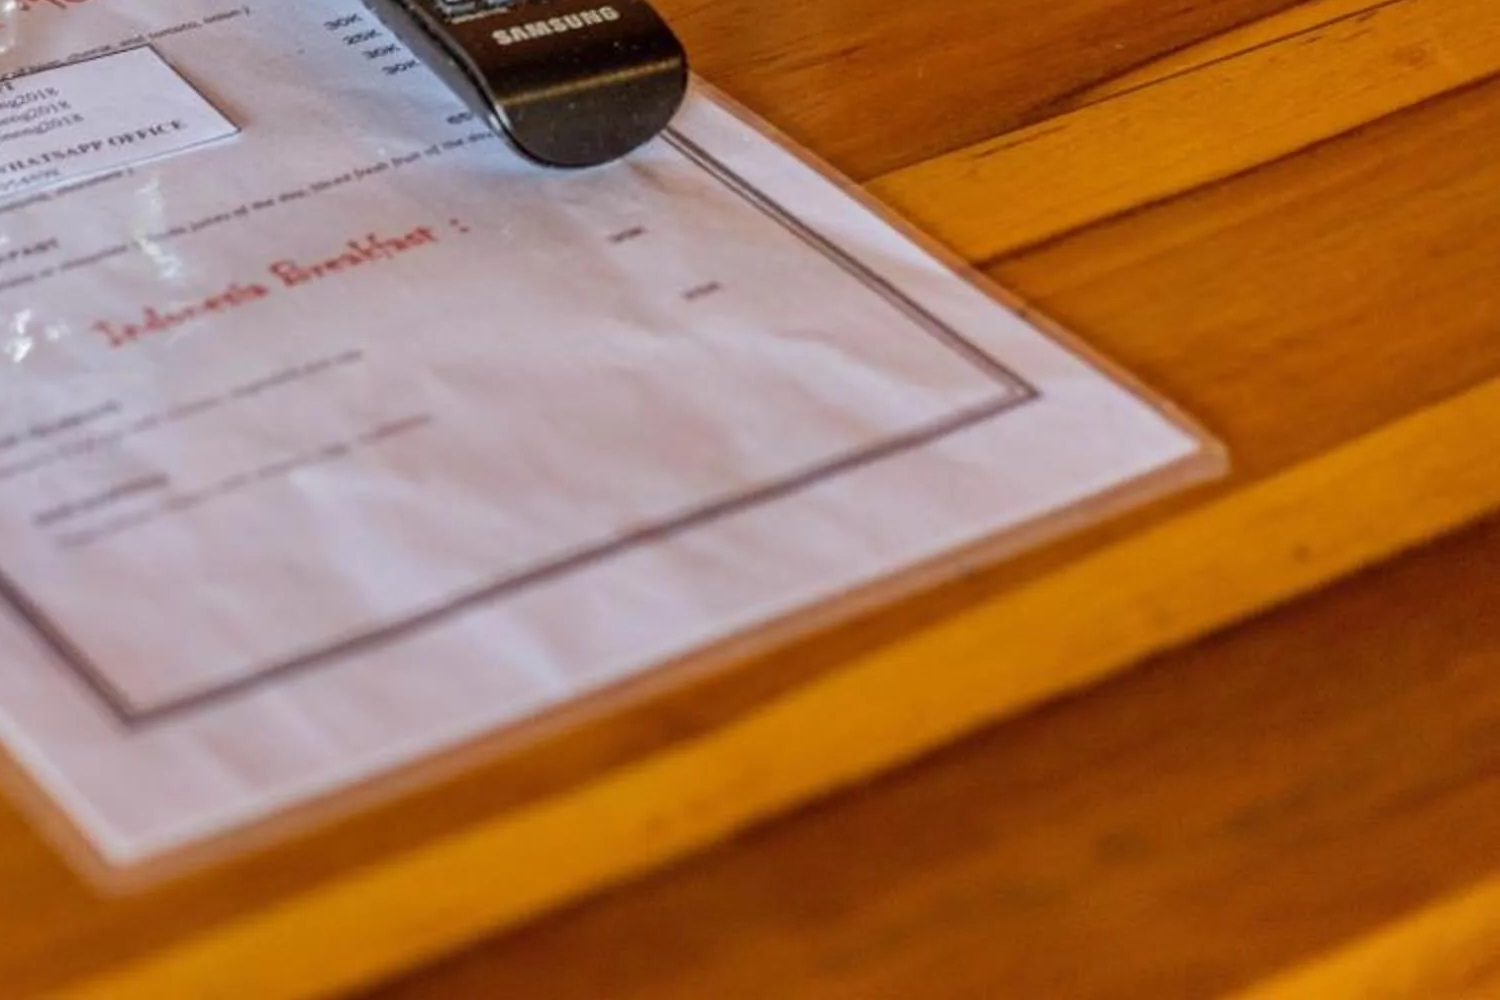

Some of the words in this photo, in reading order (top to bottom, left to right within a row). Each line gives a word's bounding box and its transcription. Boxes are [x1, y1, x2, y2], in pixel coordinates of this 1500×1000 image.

[491, 5, 621, 46] SAMSUNG
[106, 118, 189, 149] OFFICE
[270, 225, 438, 288] Breakfast
